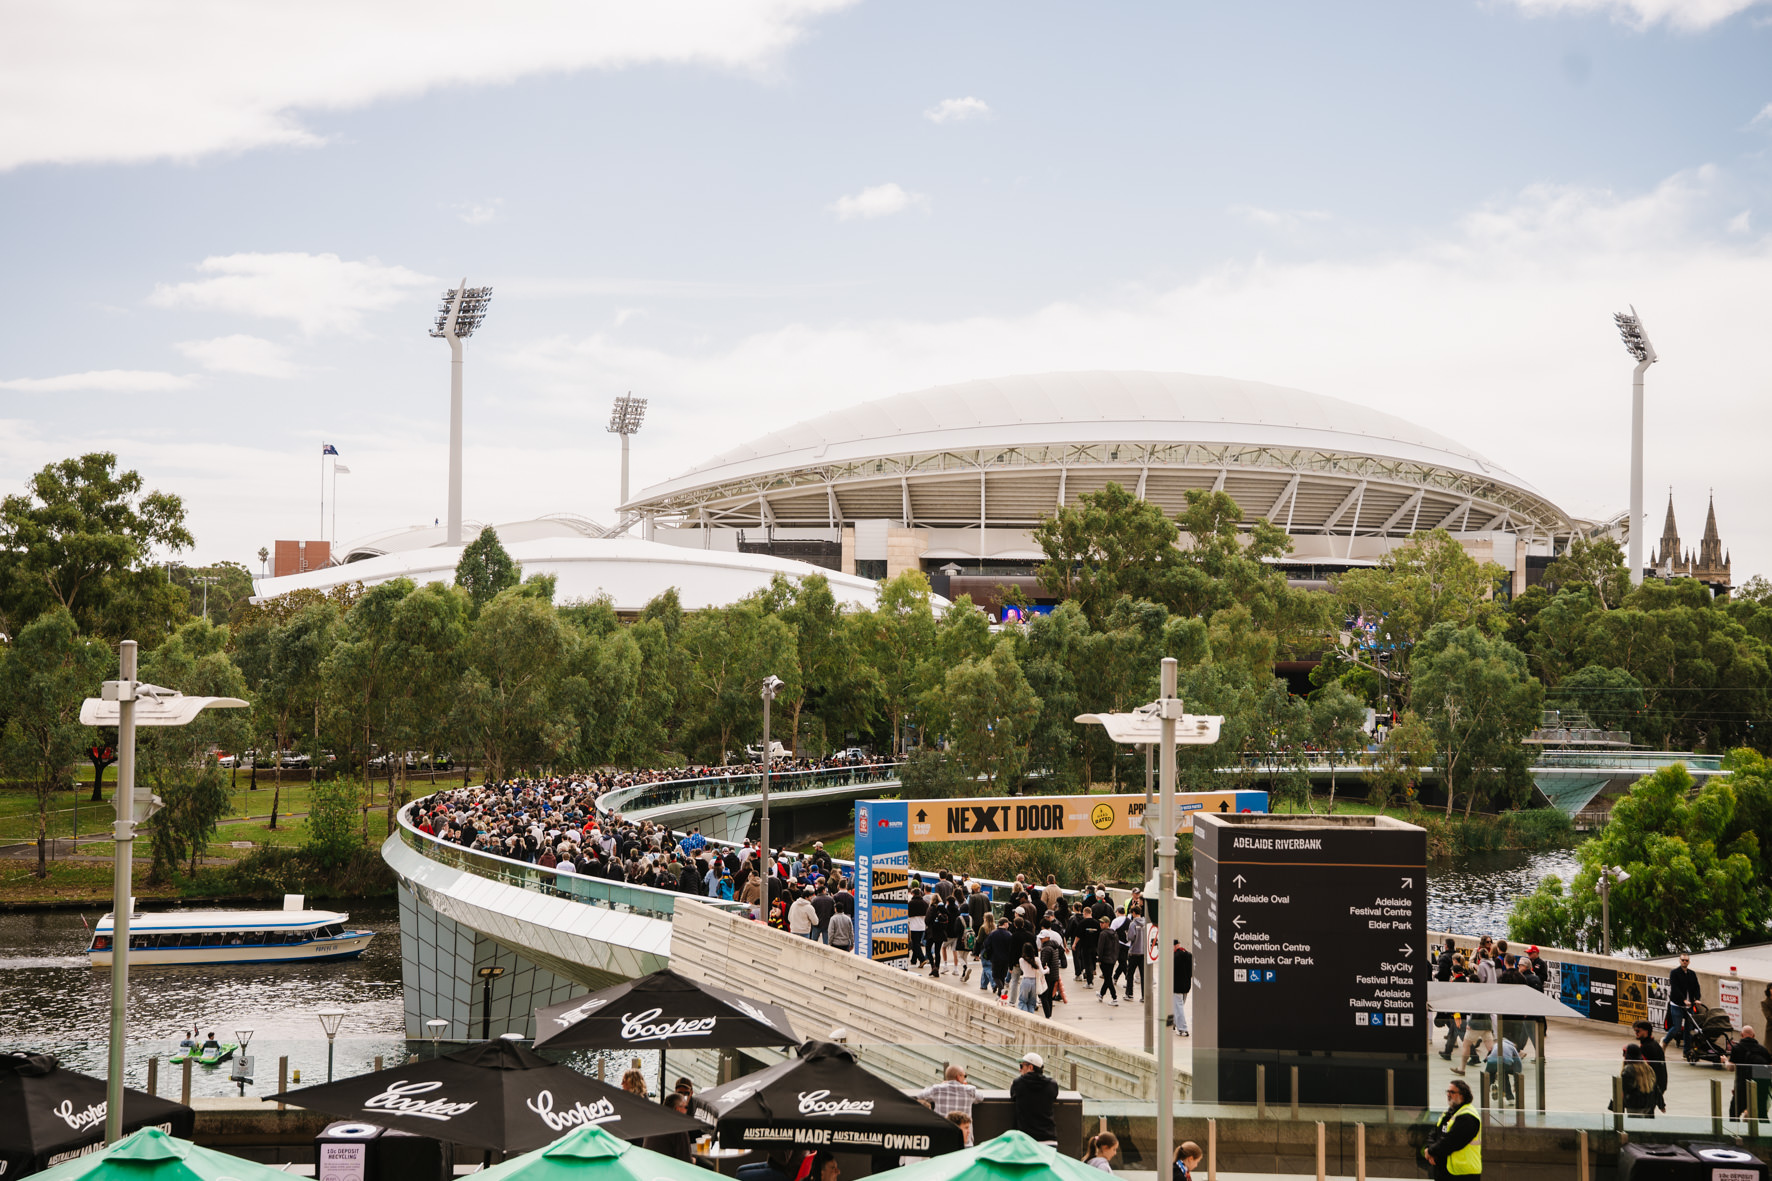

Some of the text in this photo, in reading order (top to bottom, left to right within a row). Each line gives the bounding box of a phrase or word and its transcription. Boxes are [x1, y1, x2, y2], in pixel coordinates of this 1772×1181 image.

[947, 804, 1064, 833] NEXT DOOR
[1095, 816, 1112, 825] RATED
[1233, 838, 1322, 850] ADELAIDE RIVERBANK
[872, 854, 909, 866] GATHER
[872, 870, 909, 887] ROUND
[872, 888, 909, 901] GATHER
[1233, 894, 1290, 903] Adelaide Oval
[858, 855, 869, 958] GATHER ROUND
[1375, 897, 1412, 906] Adelaide
[872, 904, 909, 923] ROUND
[1350, 907, 1412, 916] Festival Centre
[872, 922, 909, 934] GATHER
[1368, 920, 1412, 930] Elder Park
[1233, 932, 1270, 941] Adelaide
[872, 938, 909, 956] ROUND
[1233, 942, 1311, 951] Convention Centre
[882, 957, 908, 970] THER
[1233, 955, 1314, 966] Riverbank Car Park
[1380, 962, 1413, 973] SkyCity
[1266, 971, 1274, 981] P
[1356, 975, 1413, 985] Festival Plaza
[1618, 971, 1647, 982] NEXT DOOR
[1647, 975, 1663, 985] NEXT
[1374, 989, 1411, 998] Adelaide
[1349, 999, 1414, 1009] Railway Station
[1647, 999, 1666, 1008] SATURDAY
[620, 1008, 716, 1042] Coopers
[362, 1080, 478, 1121] Coopers
[798, 1090, 874, 1116] Coopers
[53, 1100, 107, 1131] Cooper
[527, 1089, 621, 1131] Coopers
[744, 1128, 930, 1150] AUSTRALIAN MADE AUSTRALIAN OWNED
